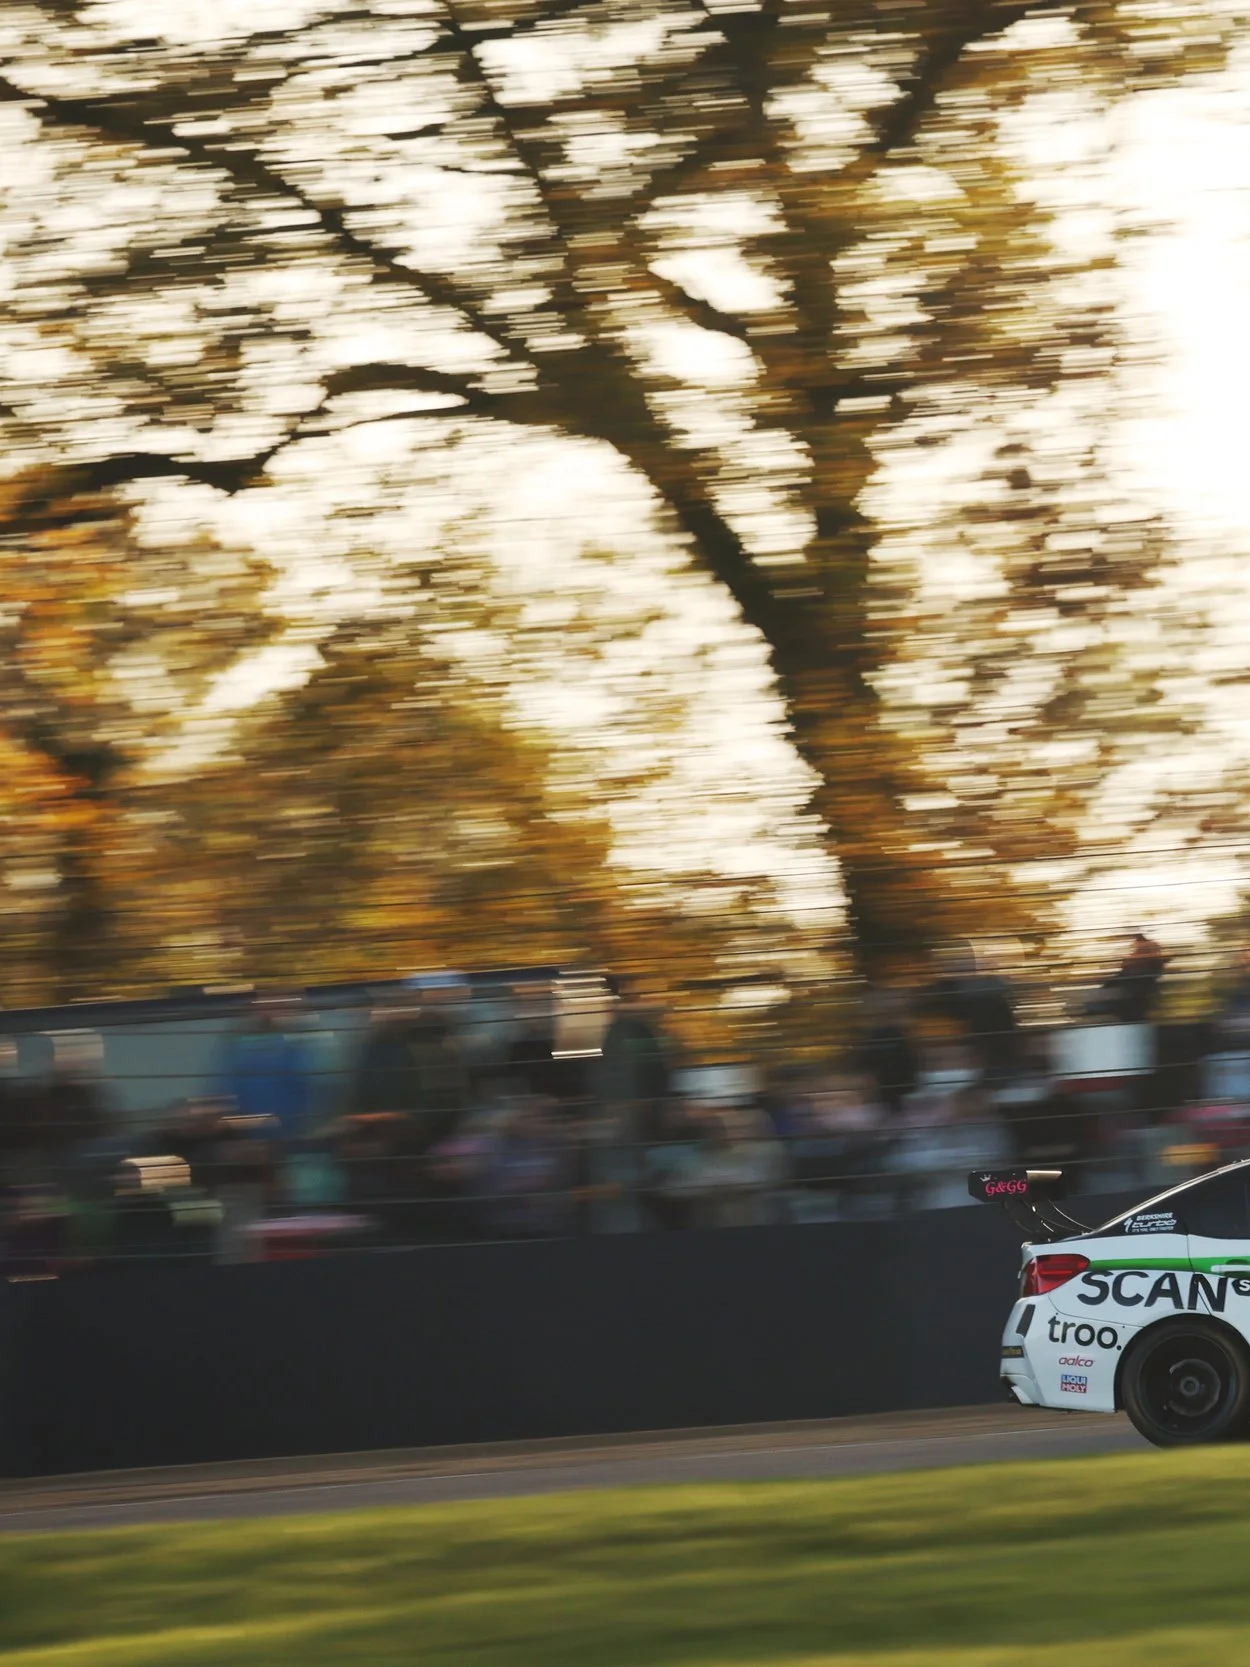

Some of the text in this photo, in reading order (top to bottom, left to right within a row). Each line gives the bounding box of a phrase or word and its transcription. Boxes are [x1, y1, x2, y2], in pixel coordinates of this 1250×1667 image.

[985, 1178, 1027, 1196] G&GG
[1076, 1270, 1228, 1313] SCAN
[1047, 1315, 1122, 1351] troo.
[1058, 1355, 1094, 1368] aalco
[1062, 1375, 1088, 1384] LIQUI
[1061, 1383, 1087, 1393] MOLY
